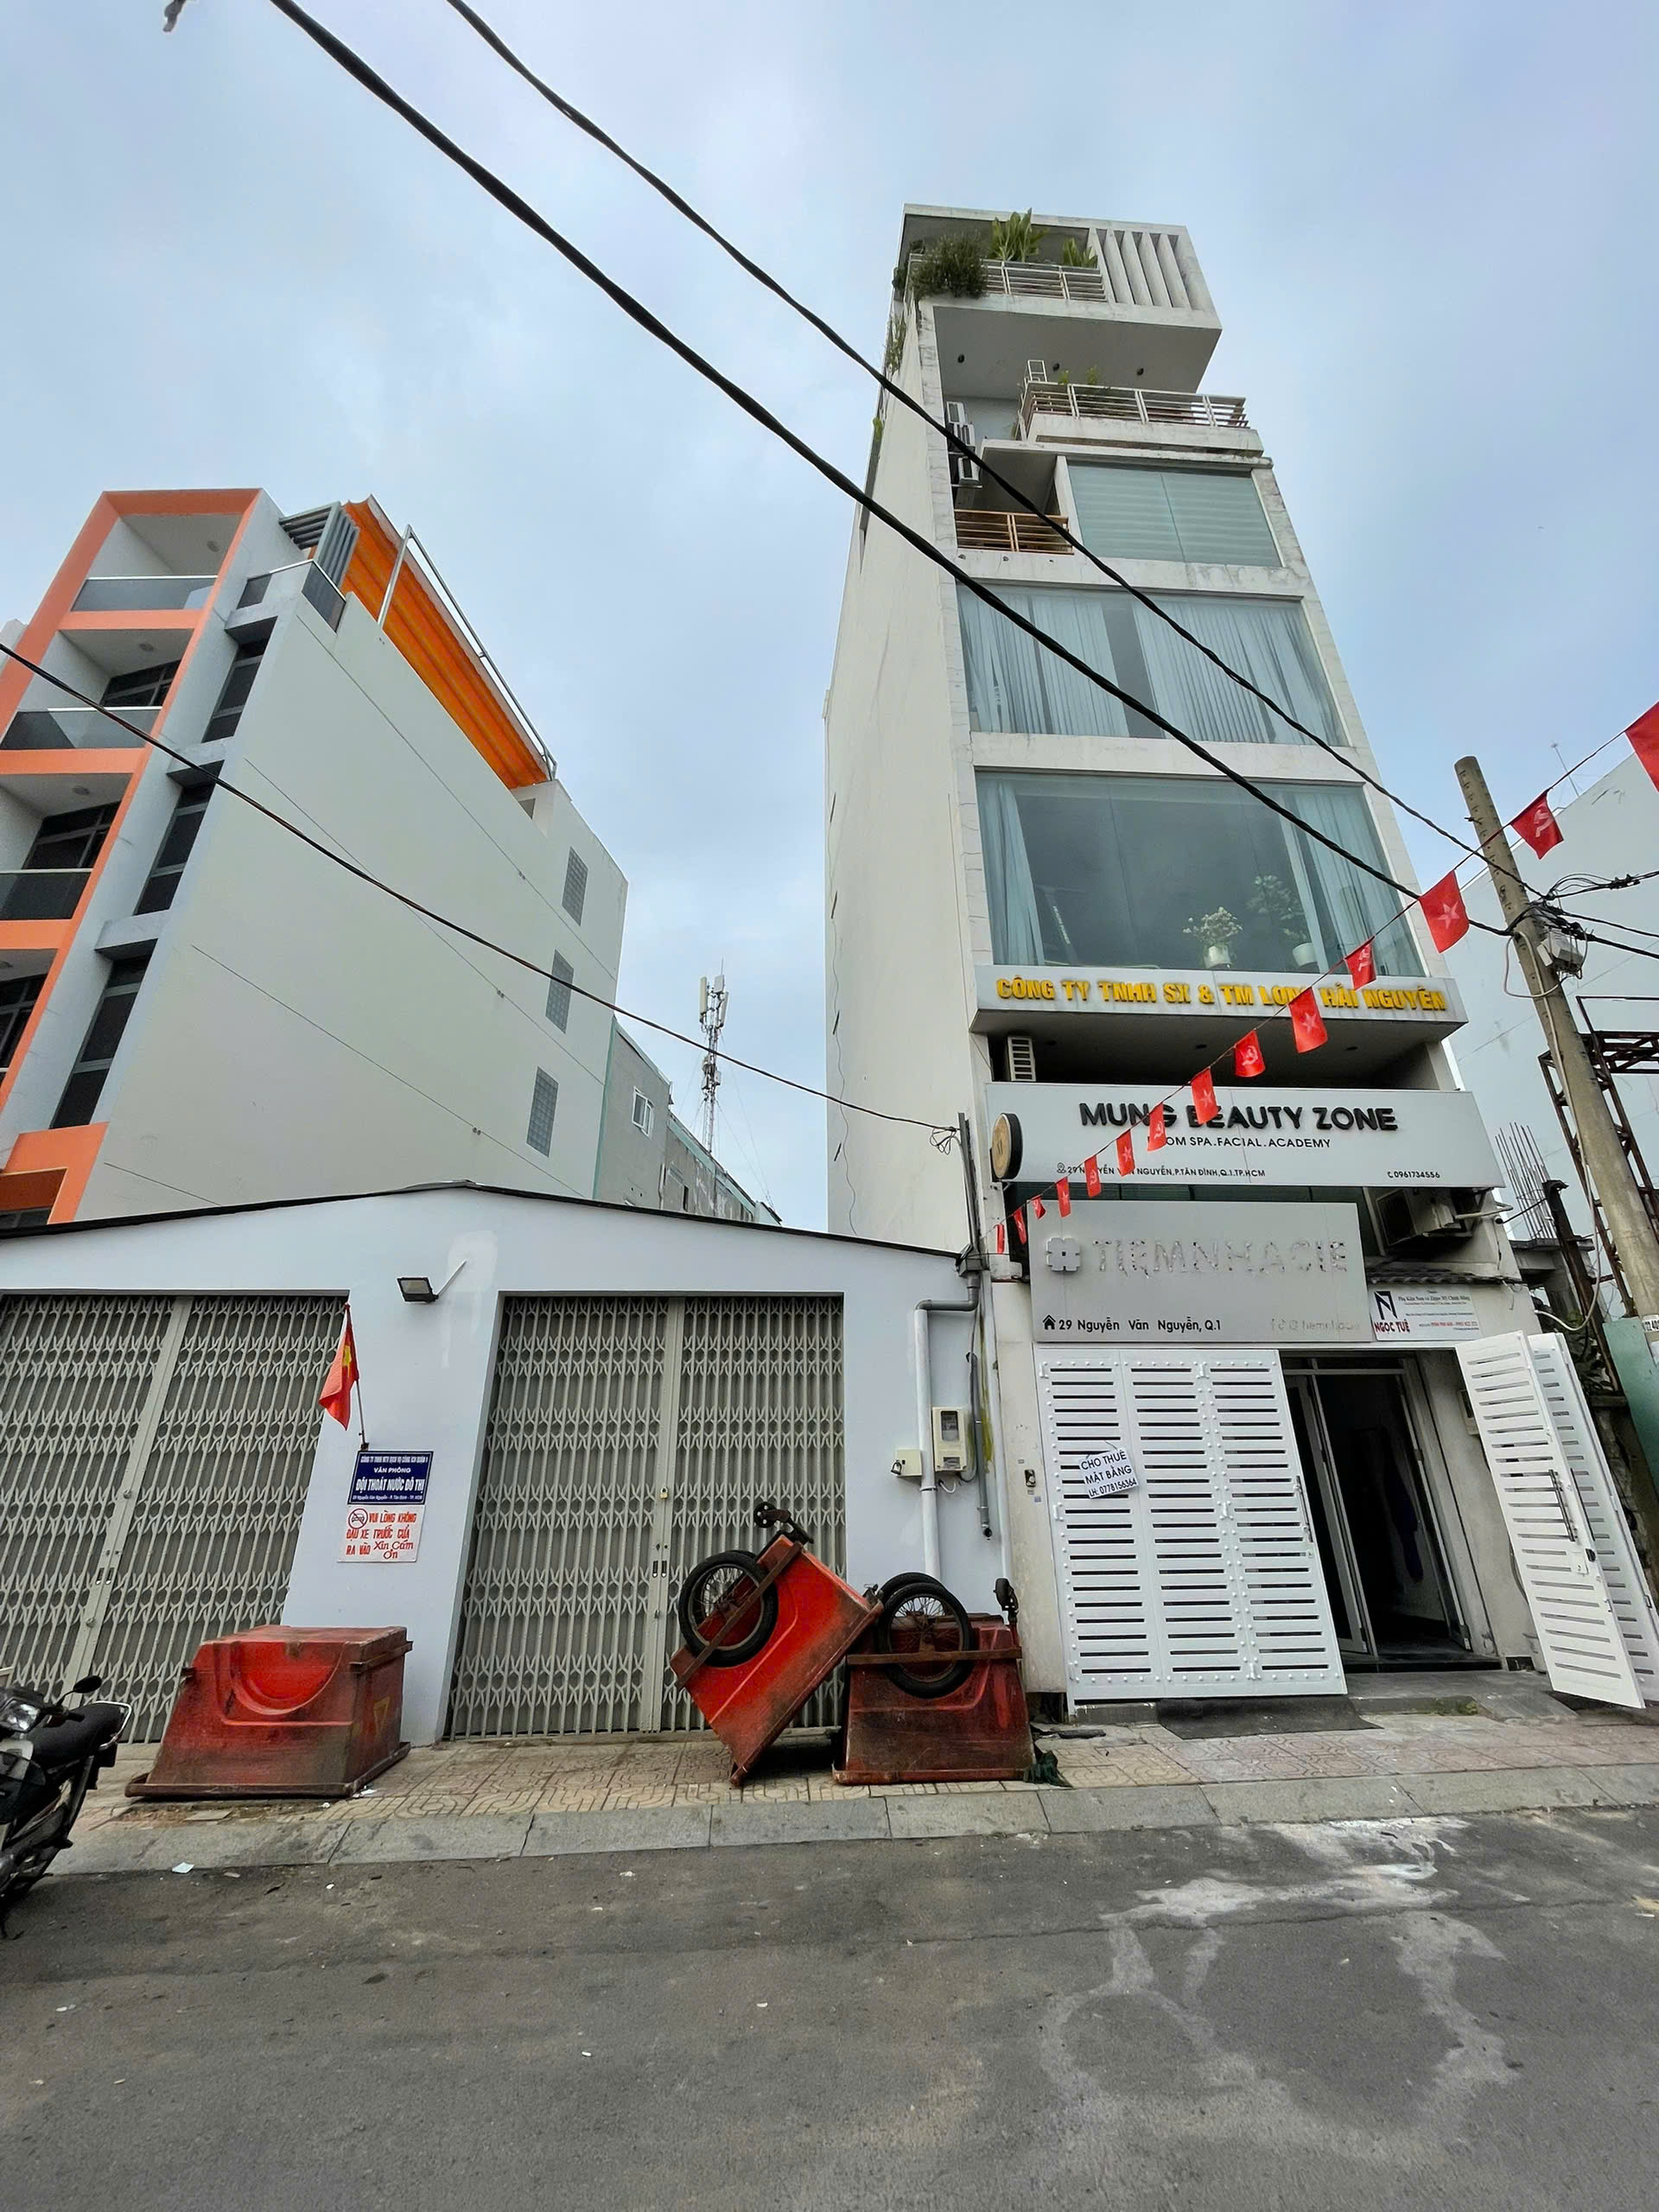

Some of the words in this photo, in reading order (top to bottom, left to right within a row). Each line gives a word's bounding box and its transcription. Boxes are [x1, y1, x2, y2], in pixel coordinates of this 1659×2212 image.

[996, 975, 1055, 1000] CÔNG
[1061, 979, 1090, 1001] TY
[1097, 980, 1158, 1003] TNHH
[1163, 982, 1191, 1003] SX
[1198, 984, 1215, 1004] &
[1219, 985, 1253, 1005] TM
[1319, 982, 1358, 1008] HẢI
[1313, 1107, 1398, 1131] ZONE
[1058, 1319, 1072, 1331] 29
[1077, 1316, 1120, 1333] Nguyễn
[1128, 1319, 1149, 1331] Văn
[1158, 1316, 1202, 1333] Nguyễn,
[1205, 1319, 1221, 1332] Q.1
[1374, 1321, 1395, 1334] NGỌC
[1395, 1319, 1410, 1333] TUỆ
[1081, 1458, 1102, 1470] CHO
[1102, 1449, 1127, 1465] THUÊ
[1085, 1471, 1104, 1484] MẶT
[1089, 1488, 1099, 1497] LH:
[380, 1510, 396, 1523] LÒNG
[360, 1529, 370, 1539] XE
[373, 1524, 393, 1539] TRƯỚC
[346, 1545, 355, 1555] RA
[359, 1542, 371, 1555] VÀO
[373, 1541, 389, 1550] Xin
